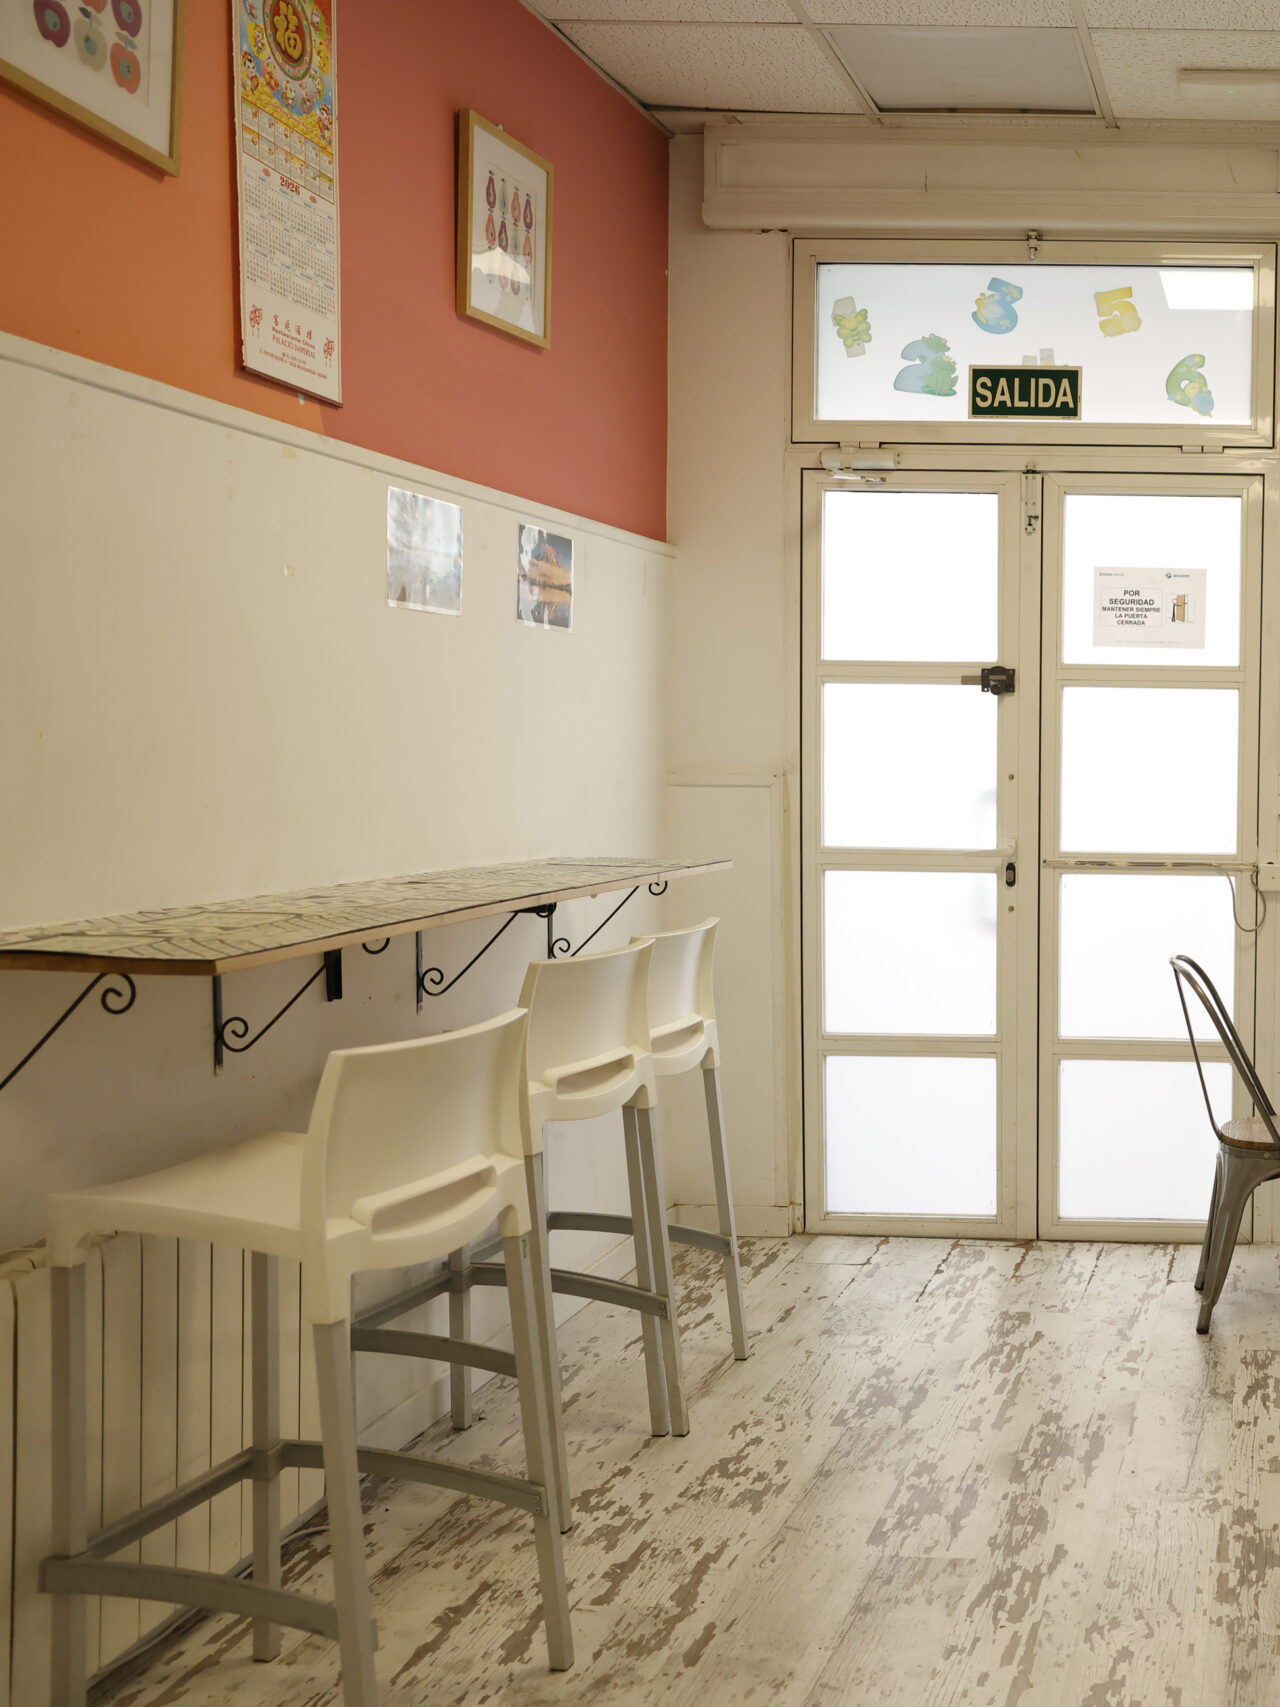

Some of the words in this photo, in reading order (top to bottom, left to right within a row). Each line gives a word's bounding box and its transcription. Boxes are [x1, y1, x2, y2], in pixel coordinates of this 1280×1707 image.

[280, 176, 300, 195] 2026
[272, 334, 293, 350] PALACIO
[294, 344, 315, 359] IMPERIAL
[976, 376, 1074, 408] SALIDA
[1109, 598, 1155, 606] SEGURIDAD
